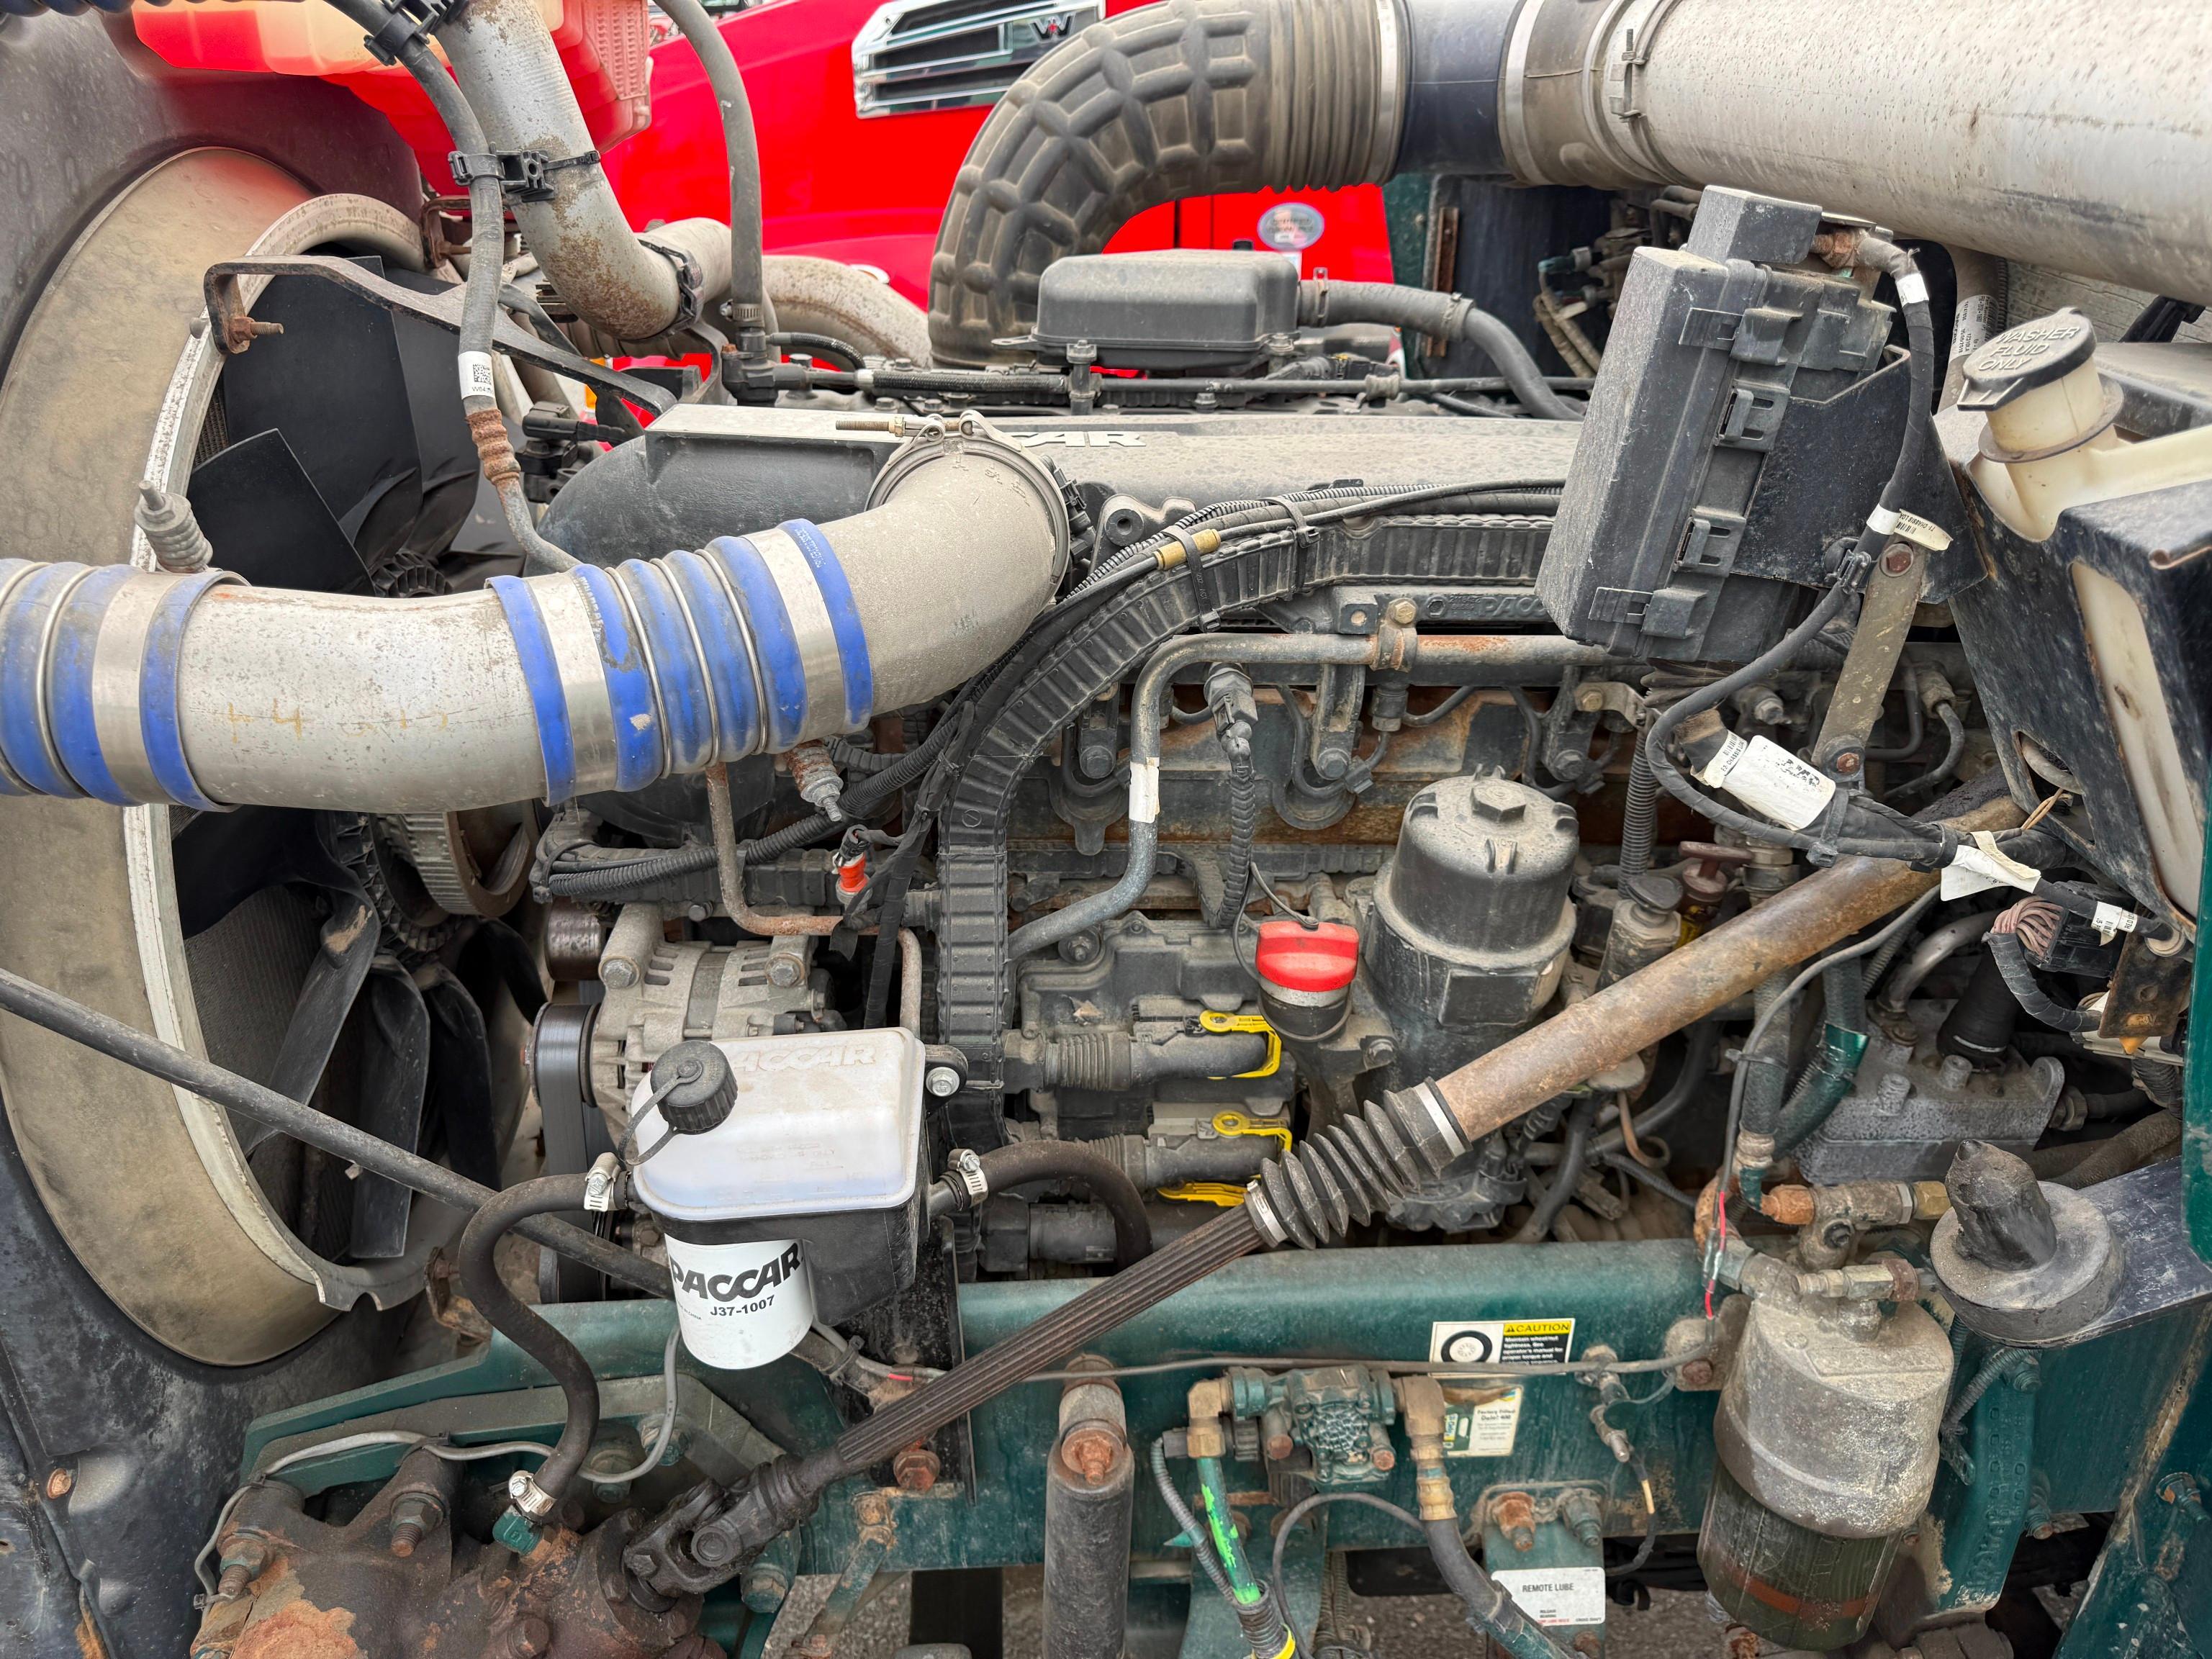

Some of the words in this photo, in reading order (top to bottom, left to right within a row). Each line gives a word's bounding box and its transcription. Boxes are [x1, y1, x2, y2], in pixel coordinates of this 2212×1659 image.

[1995, 327, 2080, 344] WASHER
[1990, 343, 2049, 357] FLUID
[1979, 358, 2032, 371] ONLY
[1908, 517, 1928, 528] CHASSIS
[1726, 748, 1741, 765] CHASSIS
[733, 1046, 876, 1072] ACCAR
[669, 1242, 799, 1303] PACCAR
[710, 1295, 775, 1316] J37-1007
[1516, 1324, 1569, 1332] CAUTION
[1522, 1584, 1553, 1593] REMOTE
[1555, 1583, 1574, 1591] LUBE
